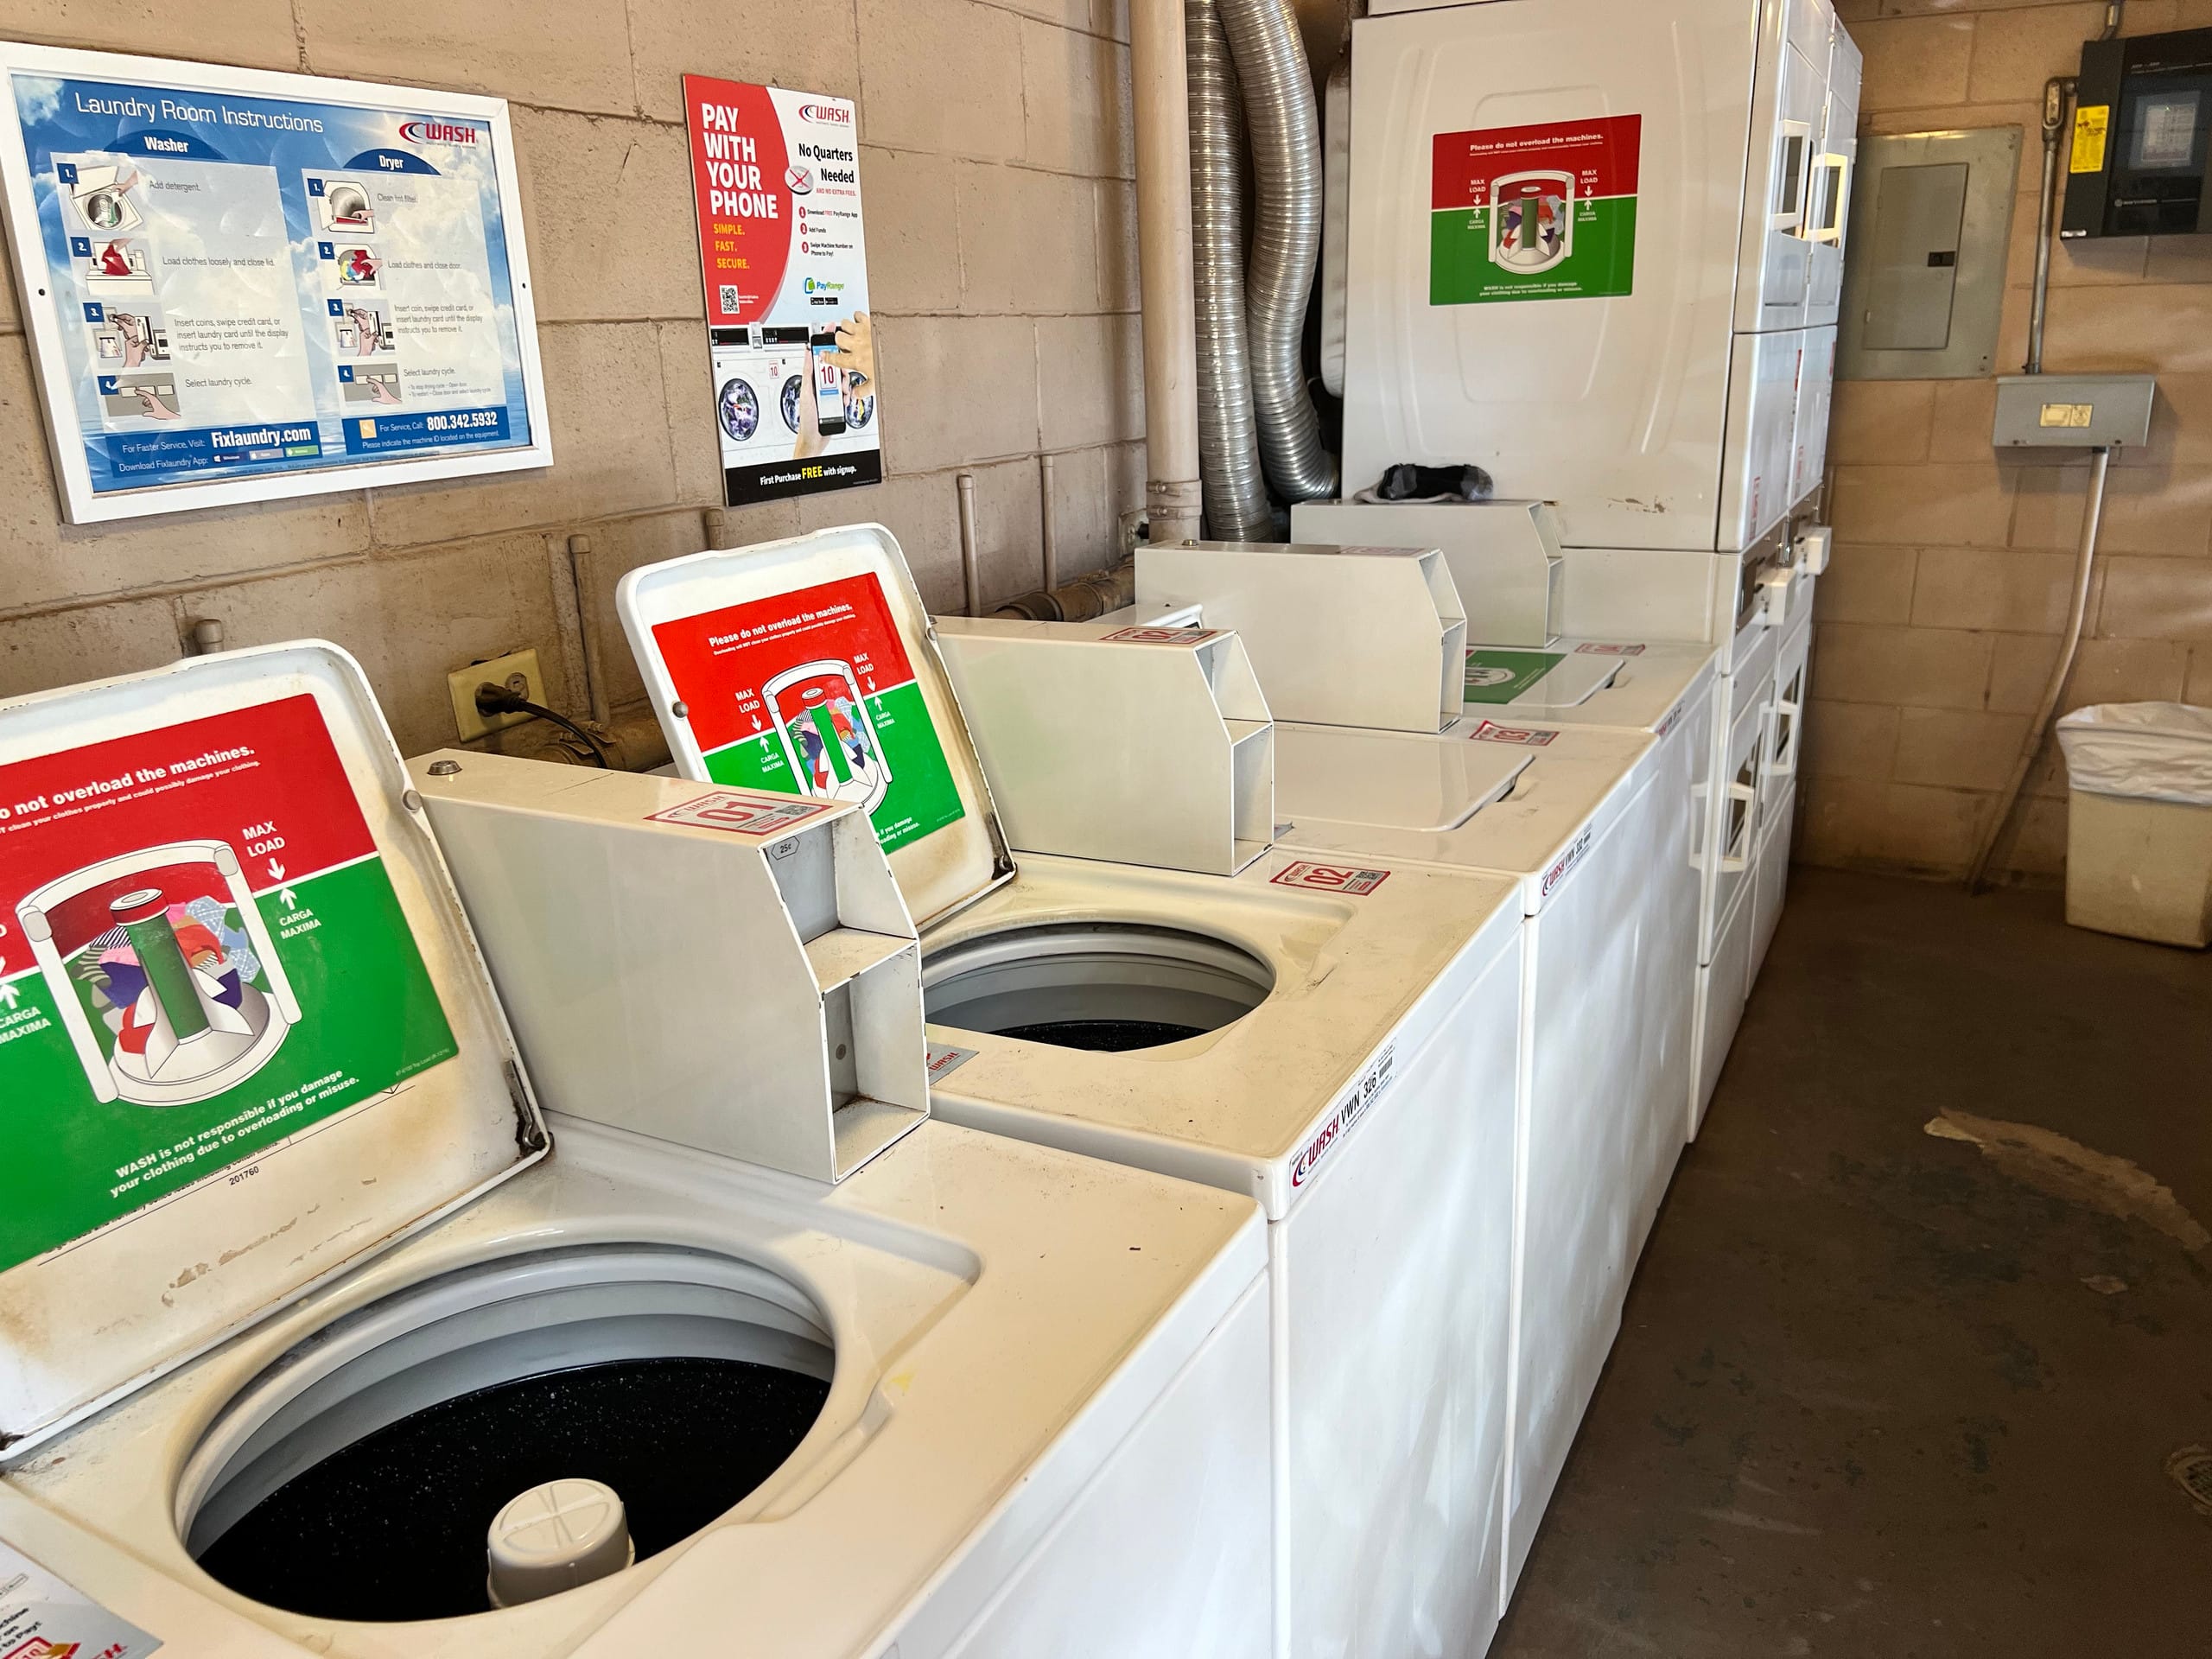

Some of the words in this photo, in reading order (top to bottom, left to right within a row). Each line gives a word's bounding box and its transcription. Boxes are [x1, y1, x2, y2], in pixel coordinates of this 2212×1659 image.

[75, 92, 156, 123] Laundry
[161, 99, 217, 123] Room
[221, 105, 324, 132] Instructions
[701, 103, 739, 133] PAY
[816, 105, 849, 124] WASH
[426, 124, 475, 143] WASH
[1519, 138, 1551, 147] overload
[1566, 133, 1603, 143] machines.
[144, 137, 188, 152] Washer
[703, 131, 757, 162] WITH
[798, 143, 811, 157] No
[813, 144, 854, 162] Quarters
[378, 155, 404, 170] Dryer
[706, 161, 763, 191] YOUR
[821, 168, 855, 183] Needed
[149, 181, 164, 189] Add
[165, 181, 201, 192] detergent.
[710, 189, 779, 219] PHONE
[713, 223, 745, 235] SIMPLE.
[715, 240, 737, 251] FAST.
[162, 257, 181, 265] Load
[208, 258, 232, 268] loosely
[716, 257, 750, 269] SECURE.
[817, 282, 844, 291] PayRange
[217, 319, 236, 328] swipe
[198, 331, 222, 340] laundry
[267, 329, 289, 339] display
[210, 344, 222, 353] you
[770, 365, 779, 378] 10
[821, 365, 835, 385] 10
[185, 378, 207, 388] Select
[208, 378, 232, 388] laundry
[233, 378, 252, 388] cycle.
[391, 423, 411, 431] Service,
[427, 411, 498, 431] 800.342.5932
[137, 443, 159, 452] Faster
[161, 442, 188, 450] Service,
[188, 439, 206, 448] Visit:
[211, 428, 311, 448] Fixlaundry.com
[382, 439, 402, 448] indicate
[441, 434, 458, 442] located
[119, 461, 155, 472] Download
[156, 458, 191, 468] Fixlaundry
[760, 475, 774, 486] First
[774, 473, 802, 484] Purchase
[802, 466, 823, 480] FREE
[823, 467, 836, 476] with
[836, 465, 857, 476] signup.
[708, 632, 739, 647] Please
[740, 628, 752, 639] do
[752, 624, 767, 636] not
[767, 615, 802, 632] overload
[802, 612, 815, 622] the
[817, 603, 853, 619] machines.
[854, 652, 869, 664] MAX
[856, 664, 874, 675] LOAD
[735, 688, 754, 702] MAX
[739, 700, 760, 714] LOAD
[875, 711, 891, 721] CARGA
[877, 718, 895, 729] MAXIMA
[760, 753, 780, 763] CARGA
[762, 760, 785, 772] MAXIMA
[14, 796, 49, 815] not
[53, 772, 135, 804] overload
[135, 767, 167, 783] the
[169, 746, 255, 775] machines.
[8, 822, 32, 832] clean
[32, 816, 52, 826] your
[53, 808, 83, 820] clothes
[85, 799, 117, 812] properly
[118, 793, 132, 803] and
[133, 788, 155, 798] could
[155, 779, 186, 793] possibly
[186, 772, 215, 785] damage
[214, 767, 231, 778] your
[696, 800, 776, 822] 01
[242, 821, 277, 840] MAX
[894, 817, 912, 830] damage
[247, 836, 286, 858] LOAD
[1303, 868, 1355, 886] 02
[279, 908, 314, 926] CARGA
[280, 918, 321, 939] MAXIMA
[929, 1052, 960, 1071] WASH
[115, 1154, 157, 1178] WASH
[159, 1148, 172, 1159] is
[174, 1136, 195, 1152] not
[197, 1106, 265, 1141] responsible
[266, 1098, 276, 1109] if
[278, 1090, 299, 1106] you
[301, 1071, 343, 1094] damage
[1308, 1114, 1340, 1166] WASH
[1341, 1090, 1360, 1124] VWN
[1363, 1071, 1376, 1099] 326
[111, 1178, 140, 1198] your
[143, 1153, 195, 1181] clothing
[197, 1141, 220, 1156] due
[221, 1134, 235, 1144] to
[238, 1102, 304, 1137] overloading
[305, 1095, 316, 1105] or
[319, 1077, 359, 1099] misuse.
[229, 1166, 260, 1185] 201760
